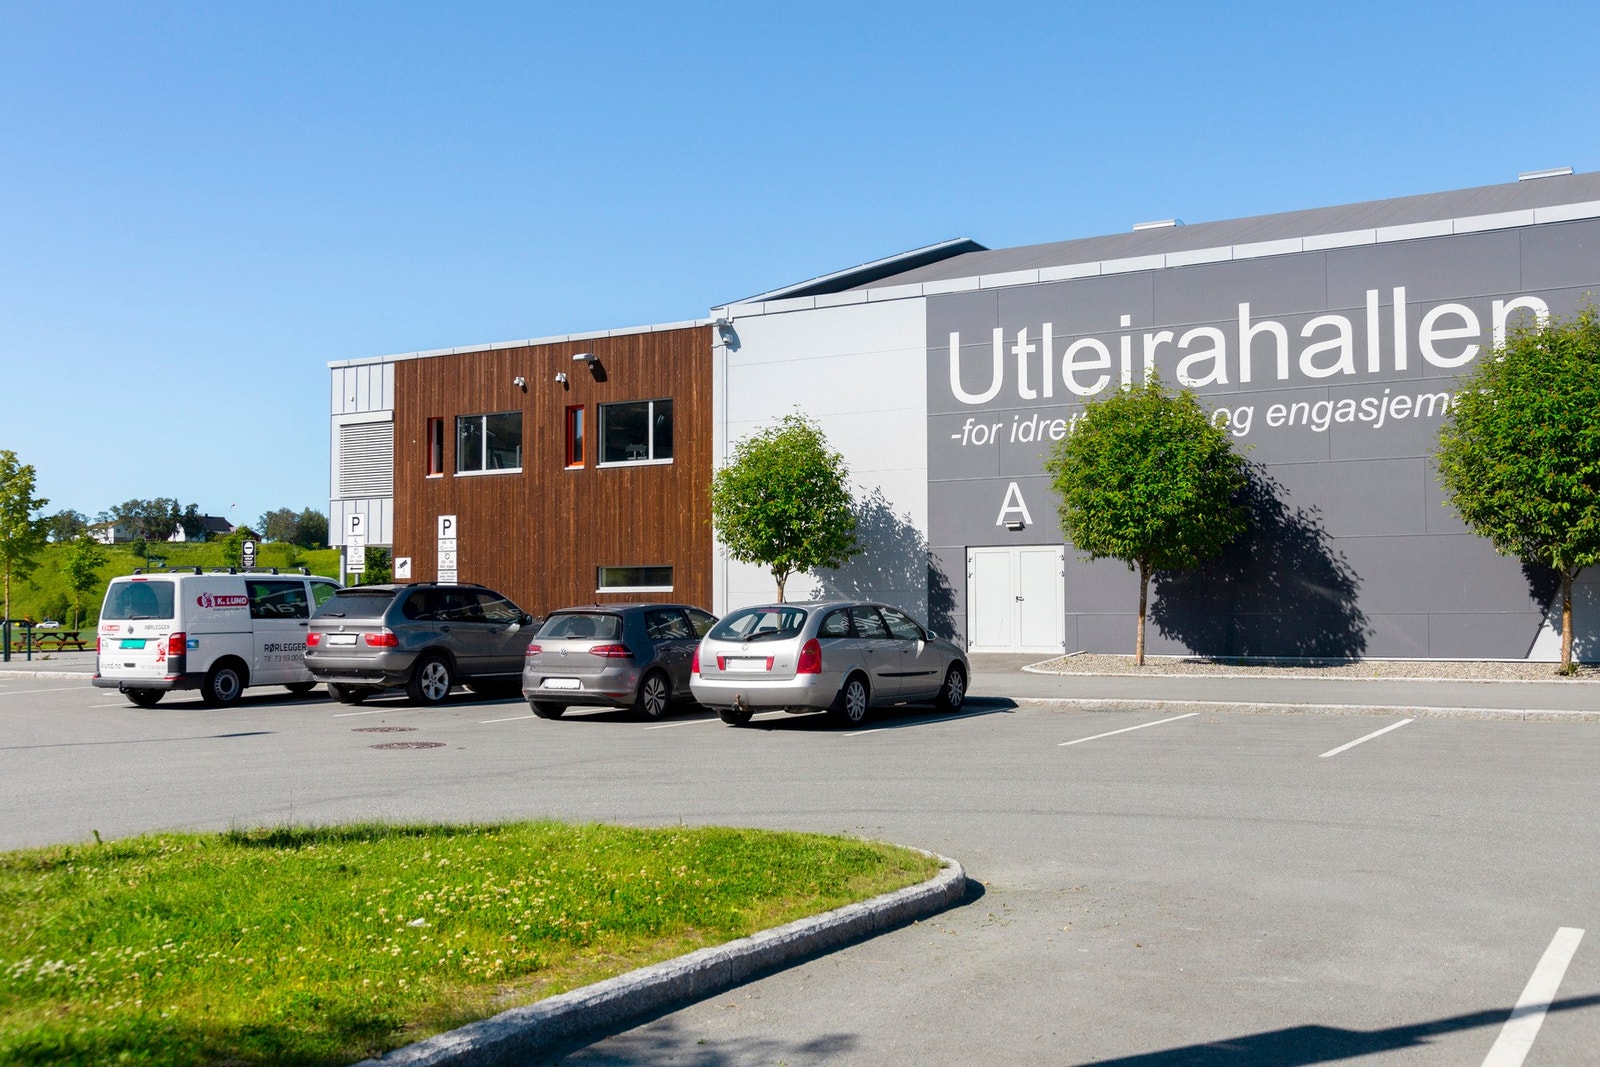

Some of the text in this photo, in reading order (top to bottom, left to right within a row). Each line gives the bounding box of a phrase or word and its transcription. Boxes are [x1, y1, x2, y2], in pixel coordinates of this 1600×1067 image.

[949, 286, 1550, 405] Utleirahallen
[951, 417, 1003, 446] -for
[1211, 406, 1255, 438] og
[995, 481, 1034, 526] A
[352, 516, 361, 533] P
[443, 519, 452, 536] P
[217, 596, 248, 605] K. LUND
[263, 642, 307, 653] RØRLEGGER
